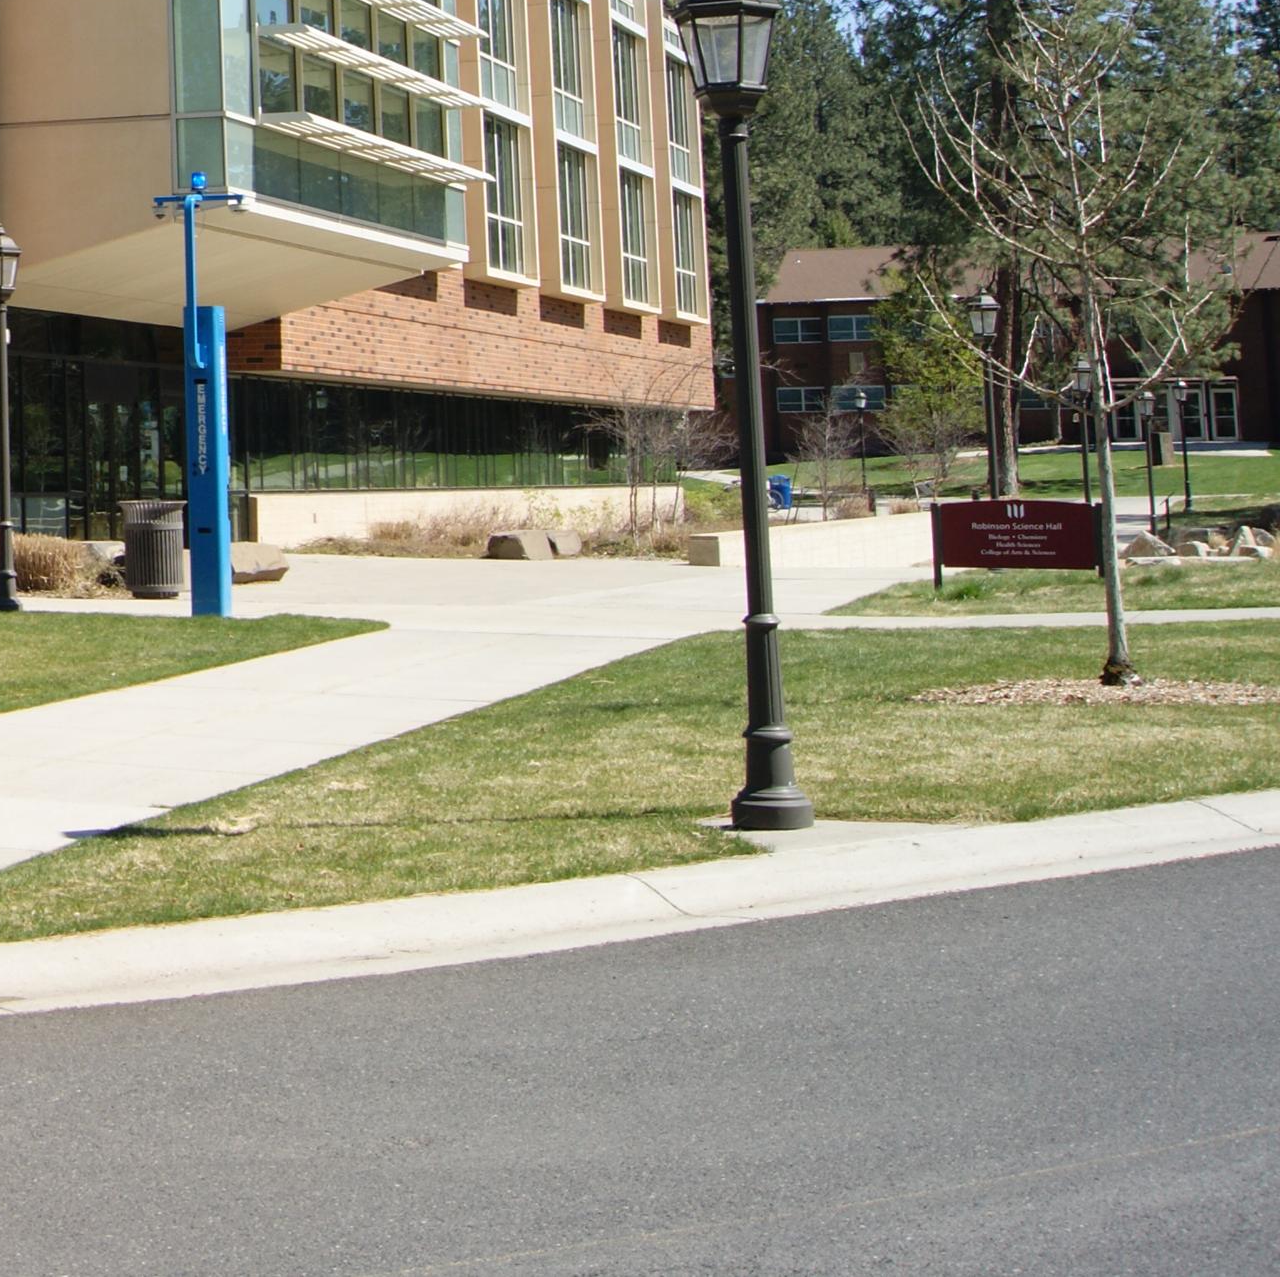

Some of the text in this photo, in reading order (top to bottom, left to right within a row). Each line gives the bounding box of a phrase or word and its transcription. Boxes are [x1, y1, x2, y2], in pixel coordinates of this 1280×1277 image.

[197, 384, 207, 475] EMERGENCY
[971, 522, 1062, 531] Robinson Science Hall
